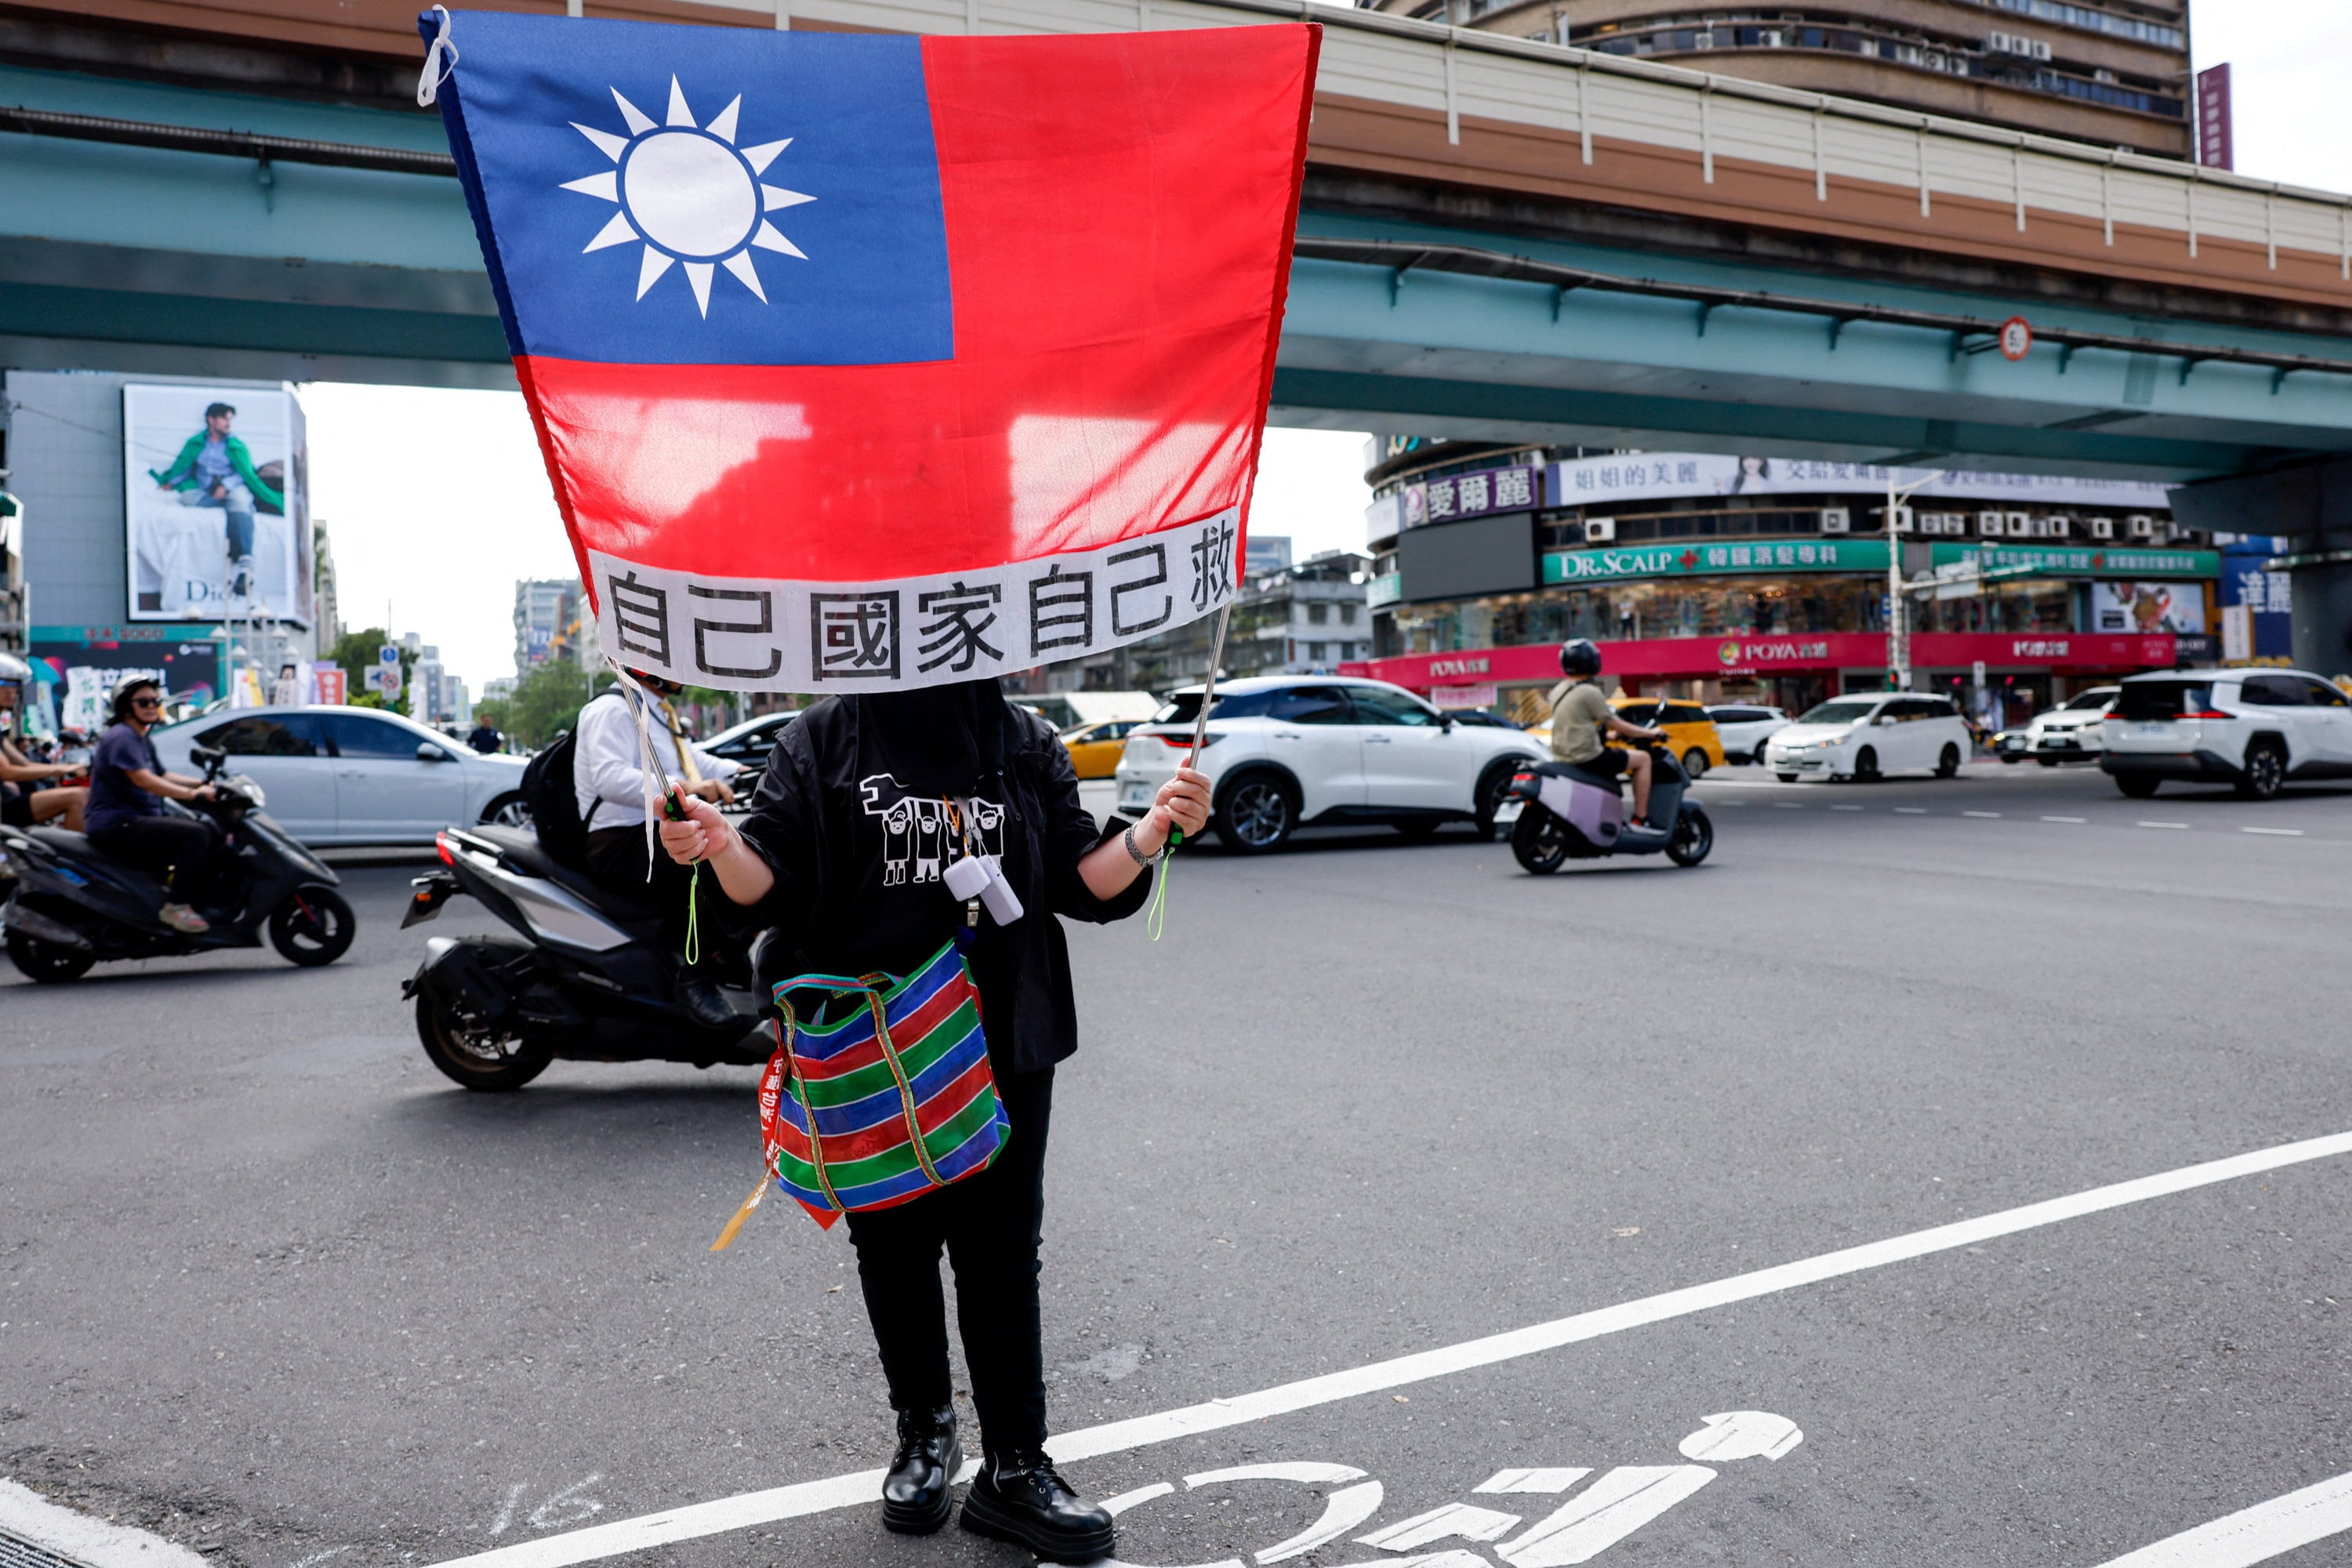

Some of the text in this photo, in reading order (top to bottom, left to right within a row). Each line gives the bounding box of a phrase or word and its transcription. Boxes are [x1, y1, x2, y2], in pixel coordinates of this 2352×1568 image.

[1428, 468, 1532, 518] 愛爾麗
[1574, 461, 1699, 491] 姐姐的美麗
[608, 521, 1236, 681] 自己國家自己救
[1744, 642, 1798, 661] POYA
